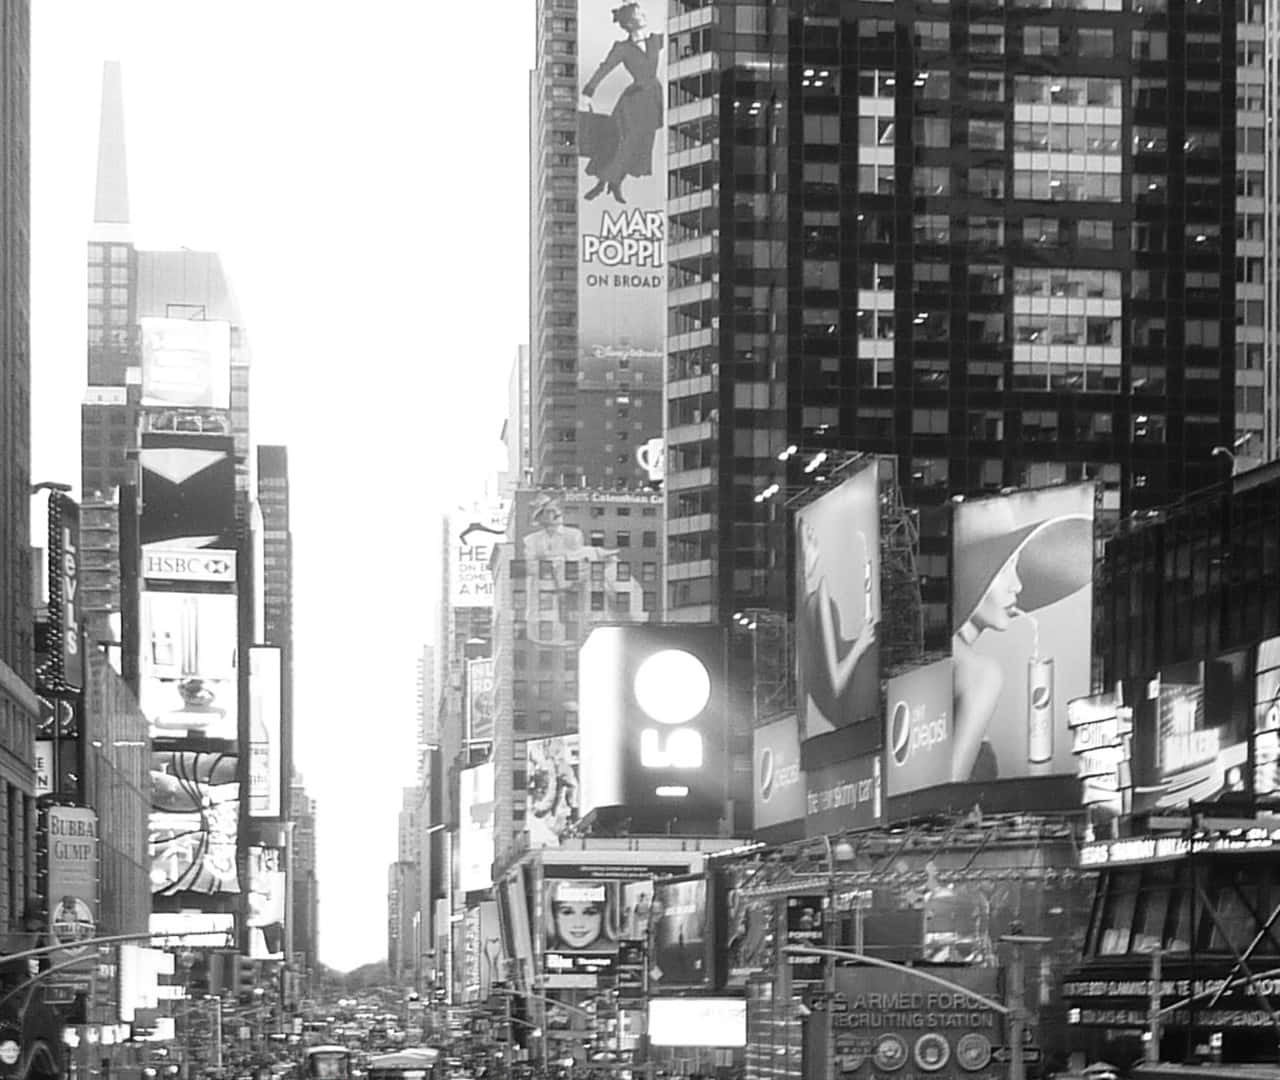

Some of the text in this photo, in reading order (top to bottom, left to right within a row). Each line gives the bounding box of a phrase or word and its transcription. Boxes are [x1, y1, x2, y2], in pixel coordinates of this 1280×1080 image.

[586, 273, 664, 289] ON BROAD
[147, 556, 202, 574] HSBC
[51, 815, 94, 838] BUBBA
[54, 840, 92, 861] GUMP
[853, 992, 923, 1010] ARMED
[926, 1013, 994, 1028] STATION
